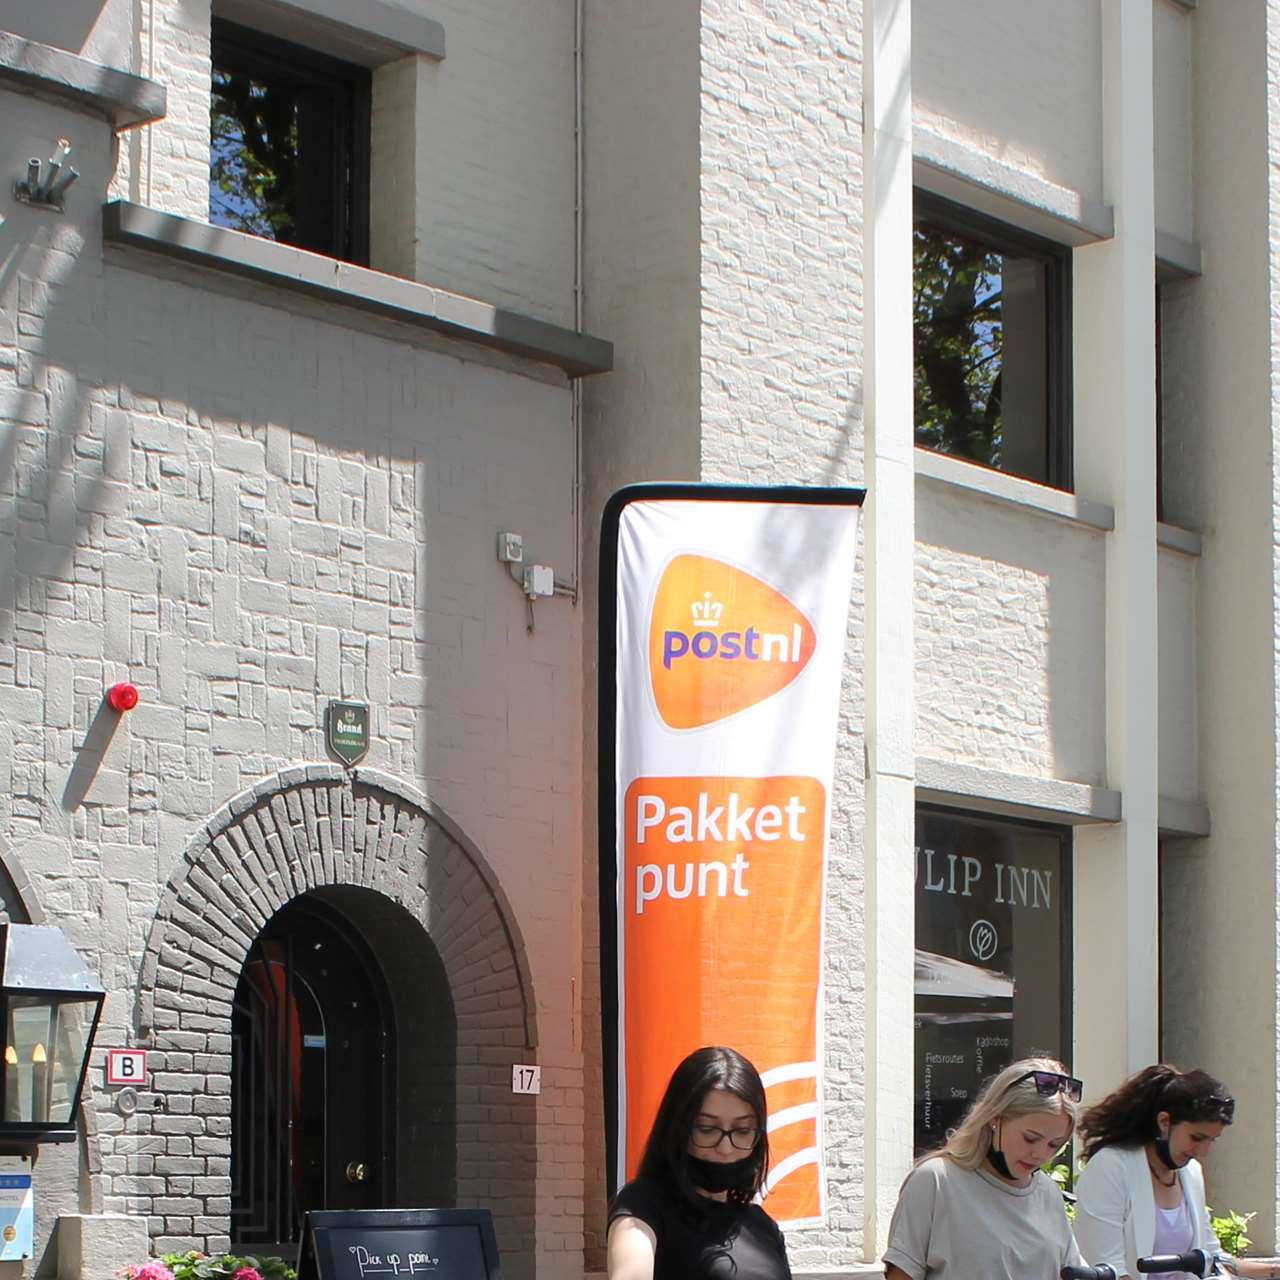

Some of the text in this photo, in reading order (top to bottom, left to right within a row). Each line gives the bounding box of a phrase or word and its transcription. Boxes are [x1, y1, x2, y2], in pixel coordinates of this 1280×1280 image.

[663, 622, 801, 670] postnl
[635, 792, 807, 845] Pakket
[635, 853, 750, 916] punt
[995, 863, 1053, 909] INN
[122, 1057, 134, 1076] B
[519, 1069, 535, 1090] 17
[357, 1246, 431, 1278] Pick up point
